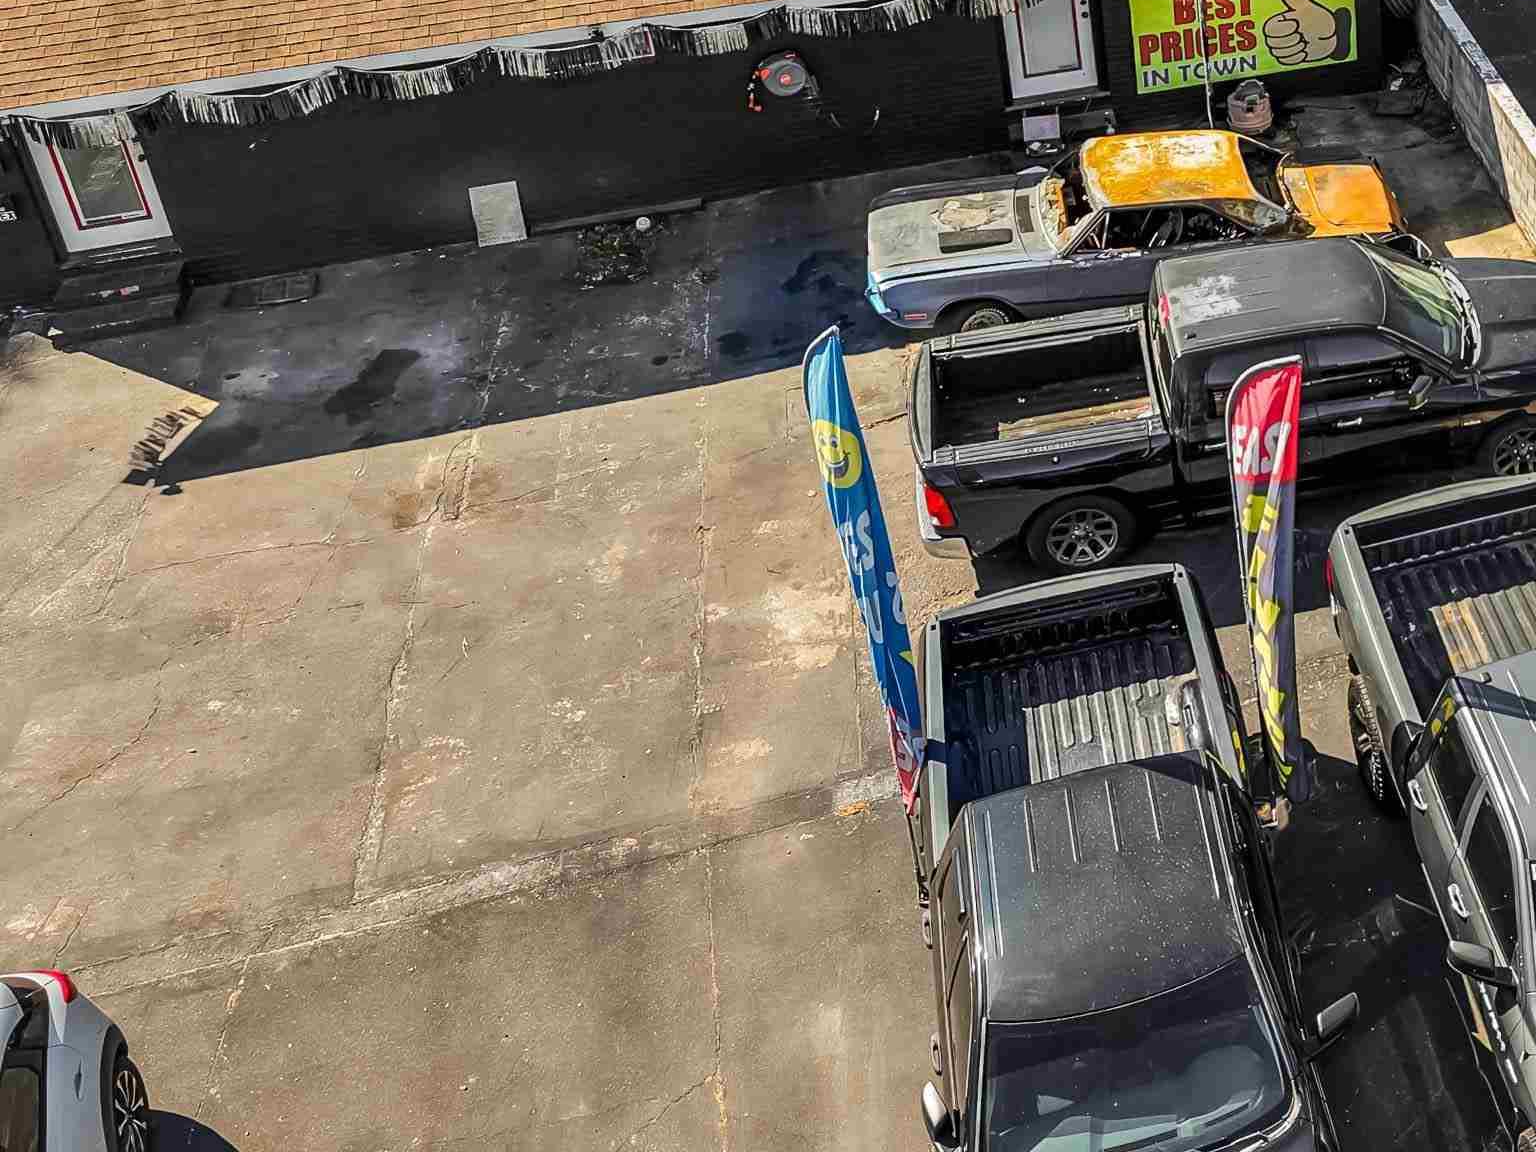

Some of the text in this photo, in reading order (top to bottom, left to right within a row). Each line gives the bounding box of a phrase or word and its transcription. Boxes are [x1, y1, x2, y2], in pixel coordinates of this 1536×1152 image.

[1139, 20, 1258, 66] PRICES
[1143, 55, 1257, 87] IN TOWN
